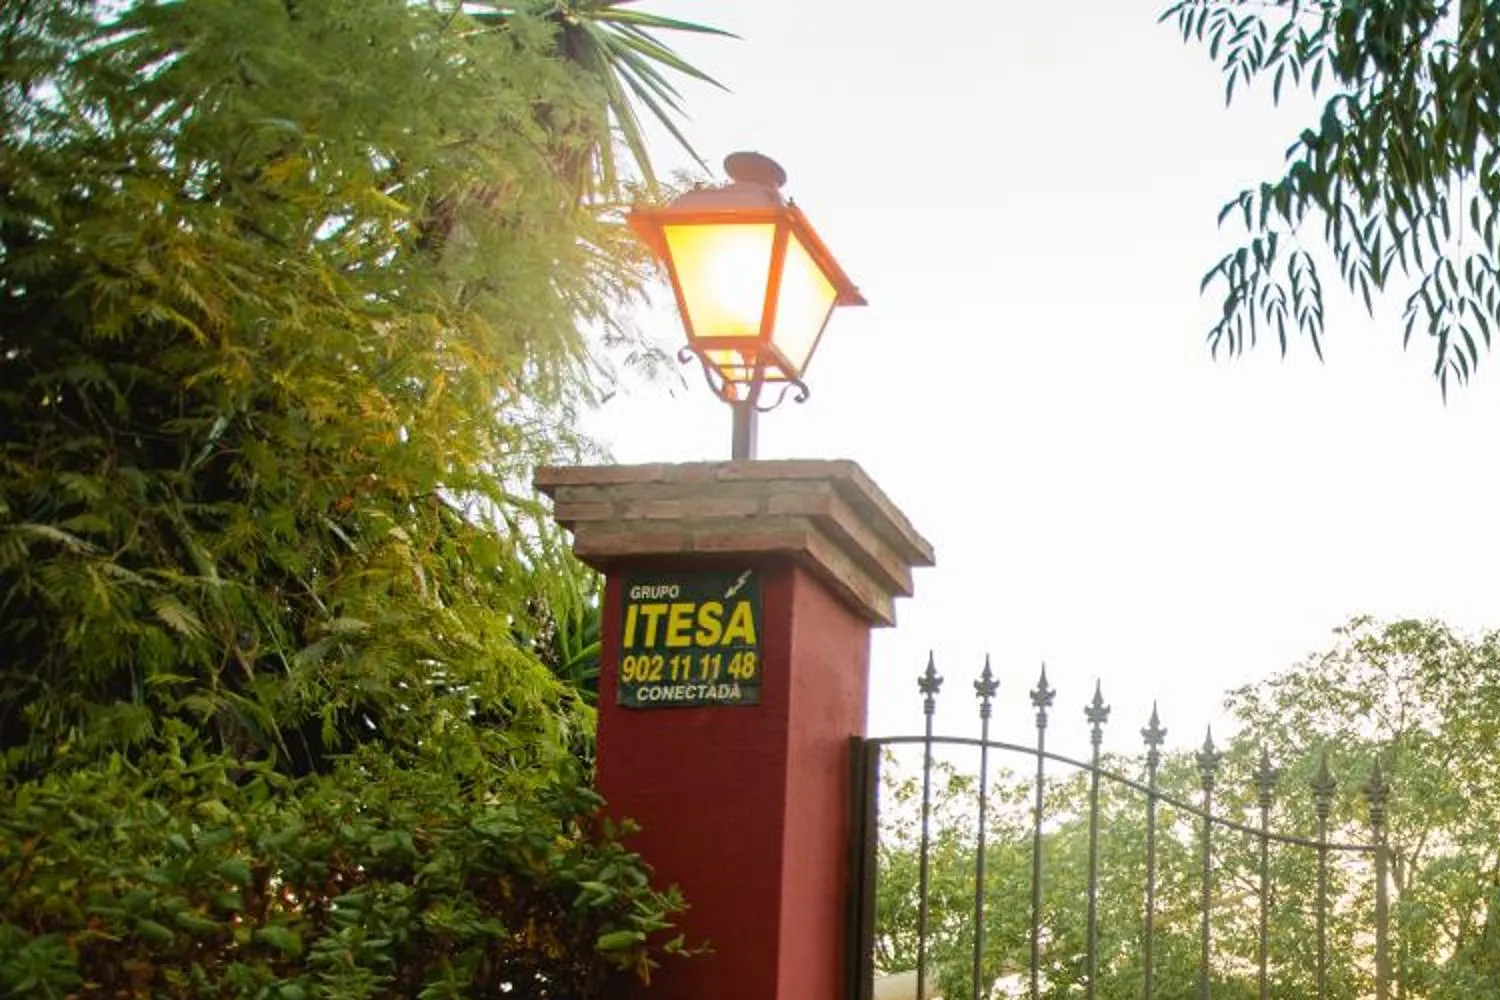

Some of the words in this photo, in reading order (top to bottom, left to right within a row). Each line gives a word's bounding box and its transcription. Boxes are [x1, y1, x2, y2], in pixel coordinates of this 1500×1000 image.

[630, 585, 680, 599] GRUPO
[623, 601, 757, 648] ITESA
[621, 655, 664, 682] 902
[670, 655, 691, 681] 11
[700, 653, 721, 680] 11
[727, 651, 756, 679] 48
[636, 683, 741, 701] CONECTADA
